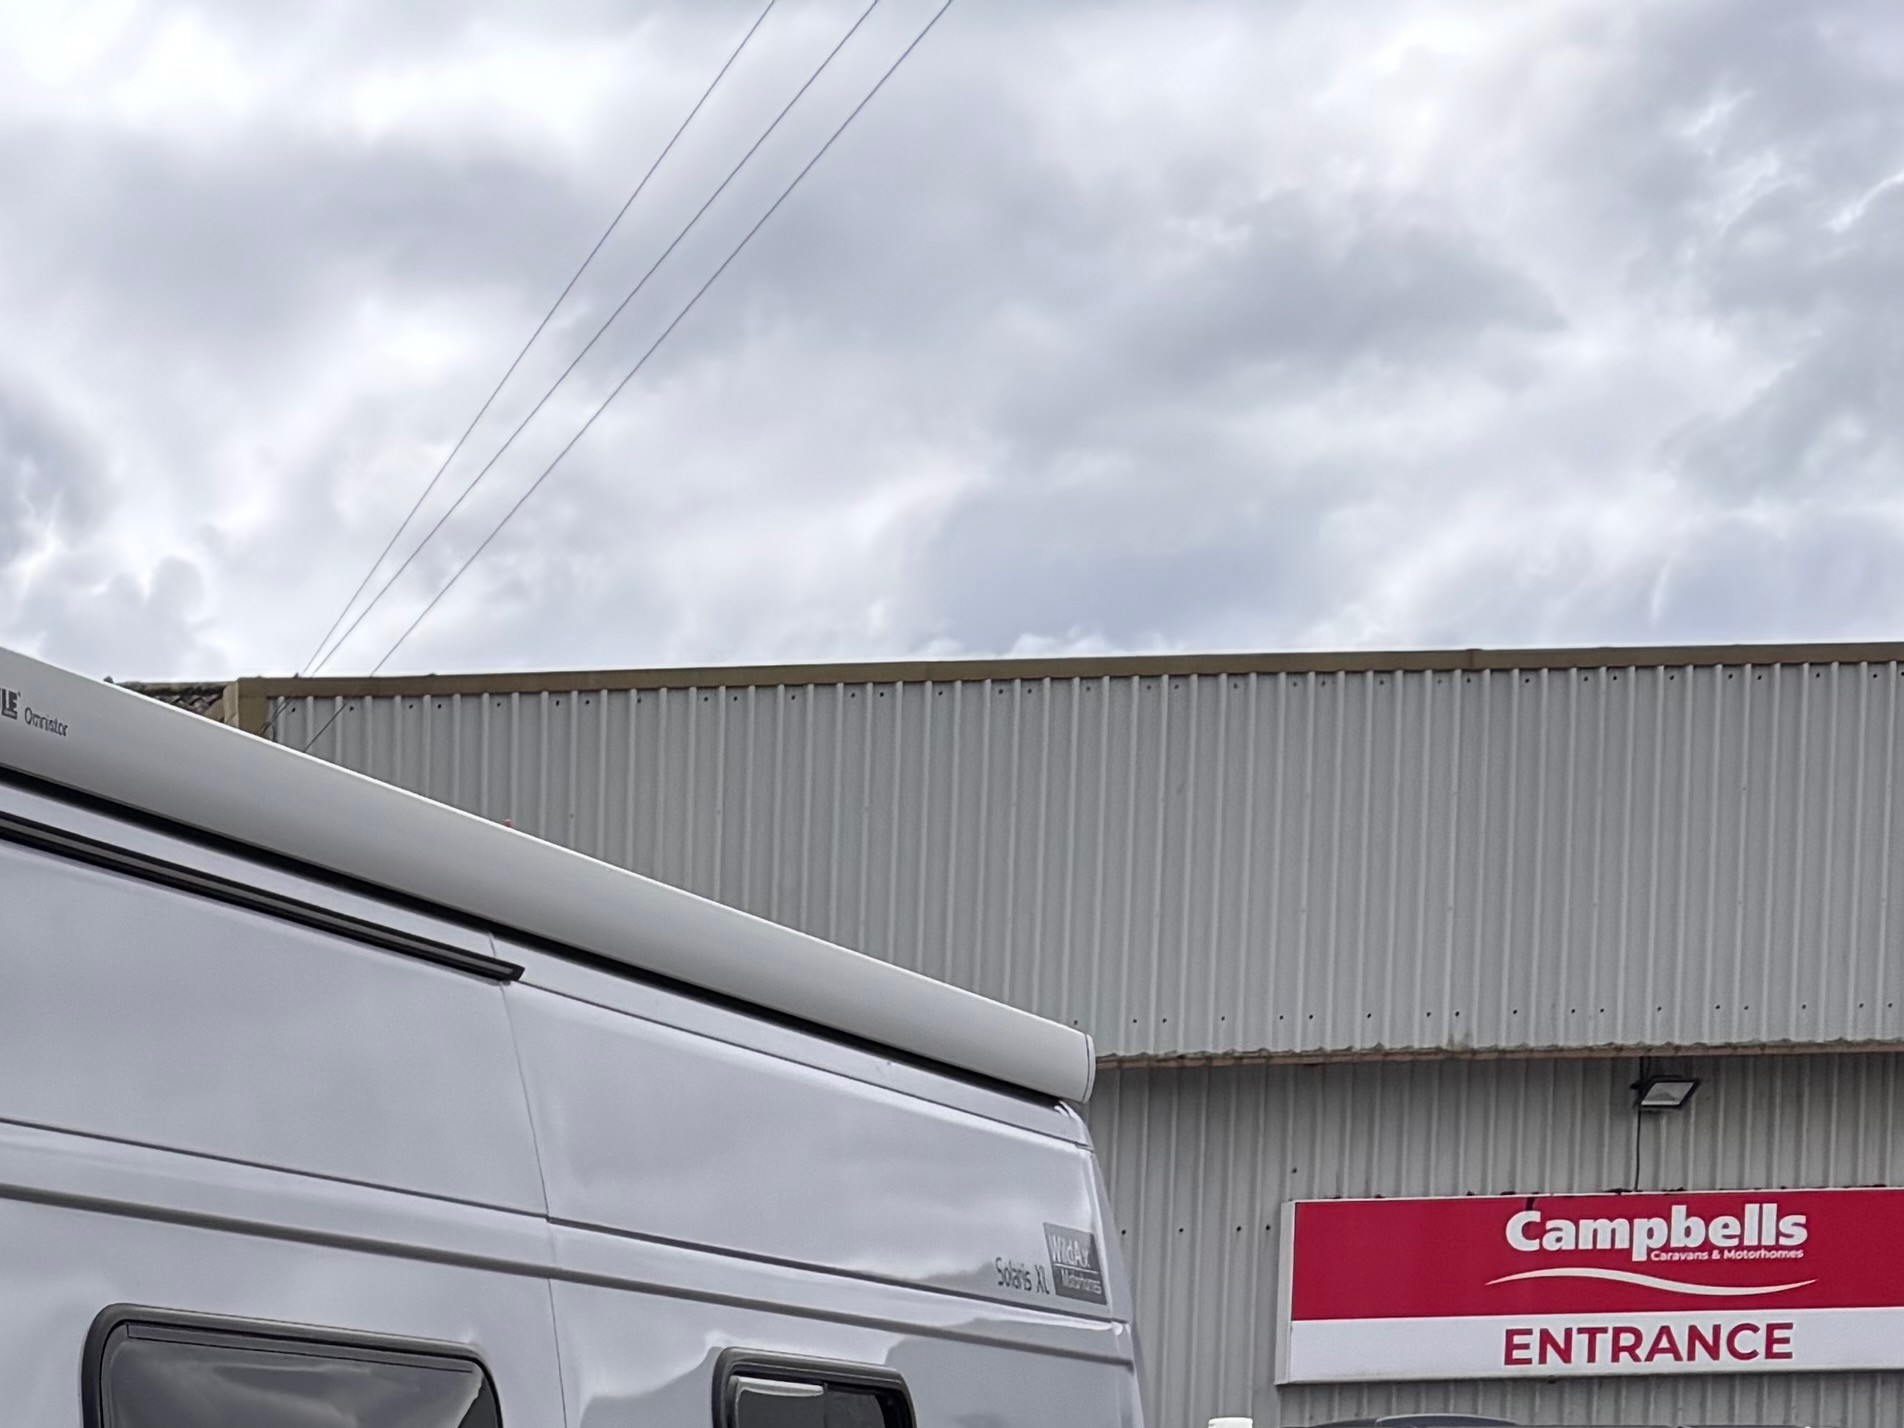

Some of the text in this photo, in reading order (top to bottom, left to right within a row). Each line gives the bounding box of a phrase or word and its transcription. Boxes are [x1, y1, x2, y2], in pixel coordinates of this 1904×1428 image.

[1048, 1233, 1092, 1269] WildAx
[1505, 1203, 1809, 1261] Campbells
[1650, 1248, 1804, 1261] Caravans & Motorhomes
[995, 1256, 1050, 1295] Solaris XL
[1504, 1322, 1794, 1366] ENTRANCE
